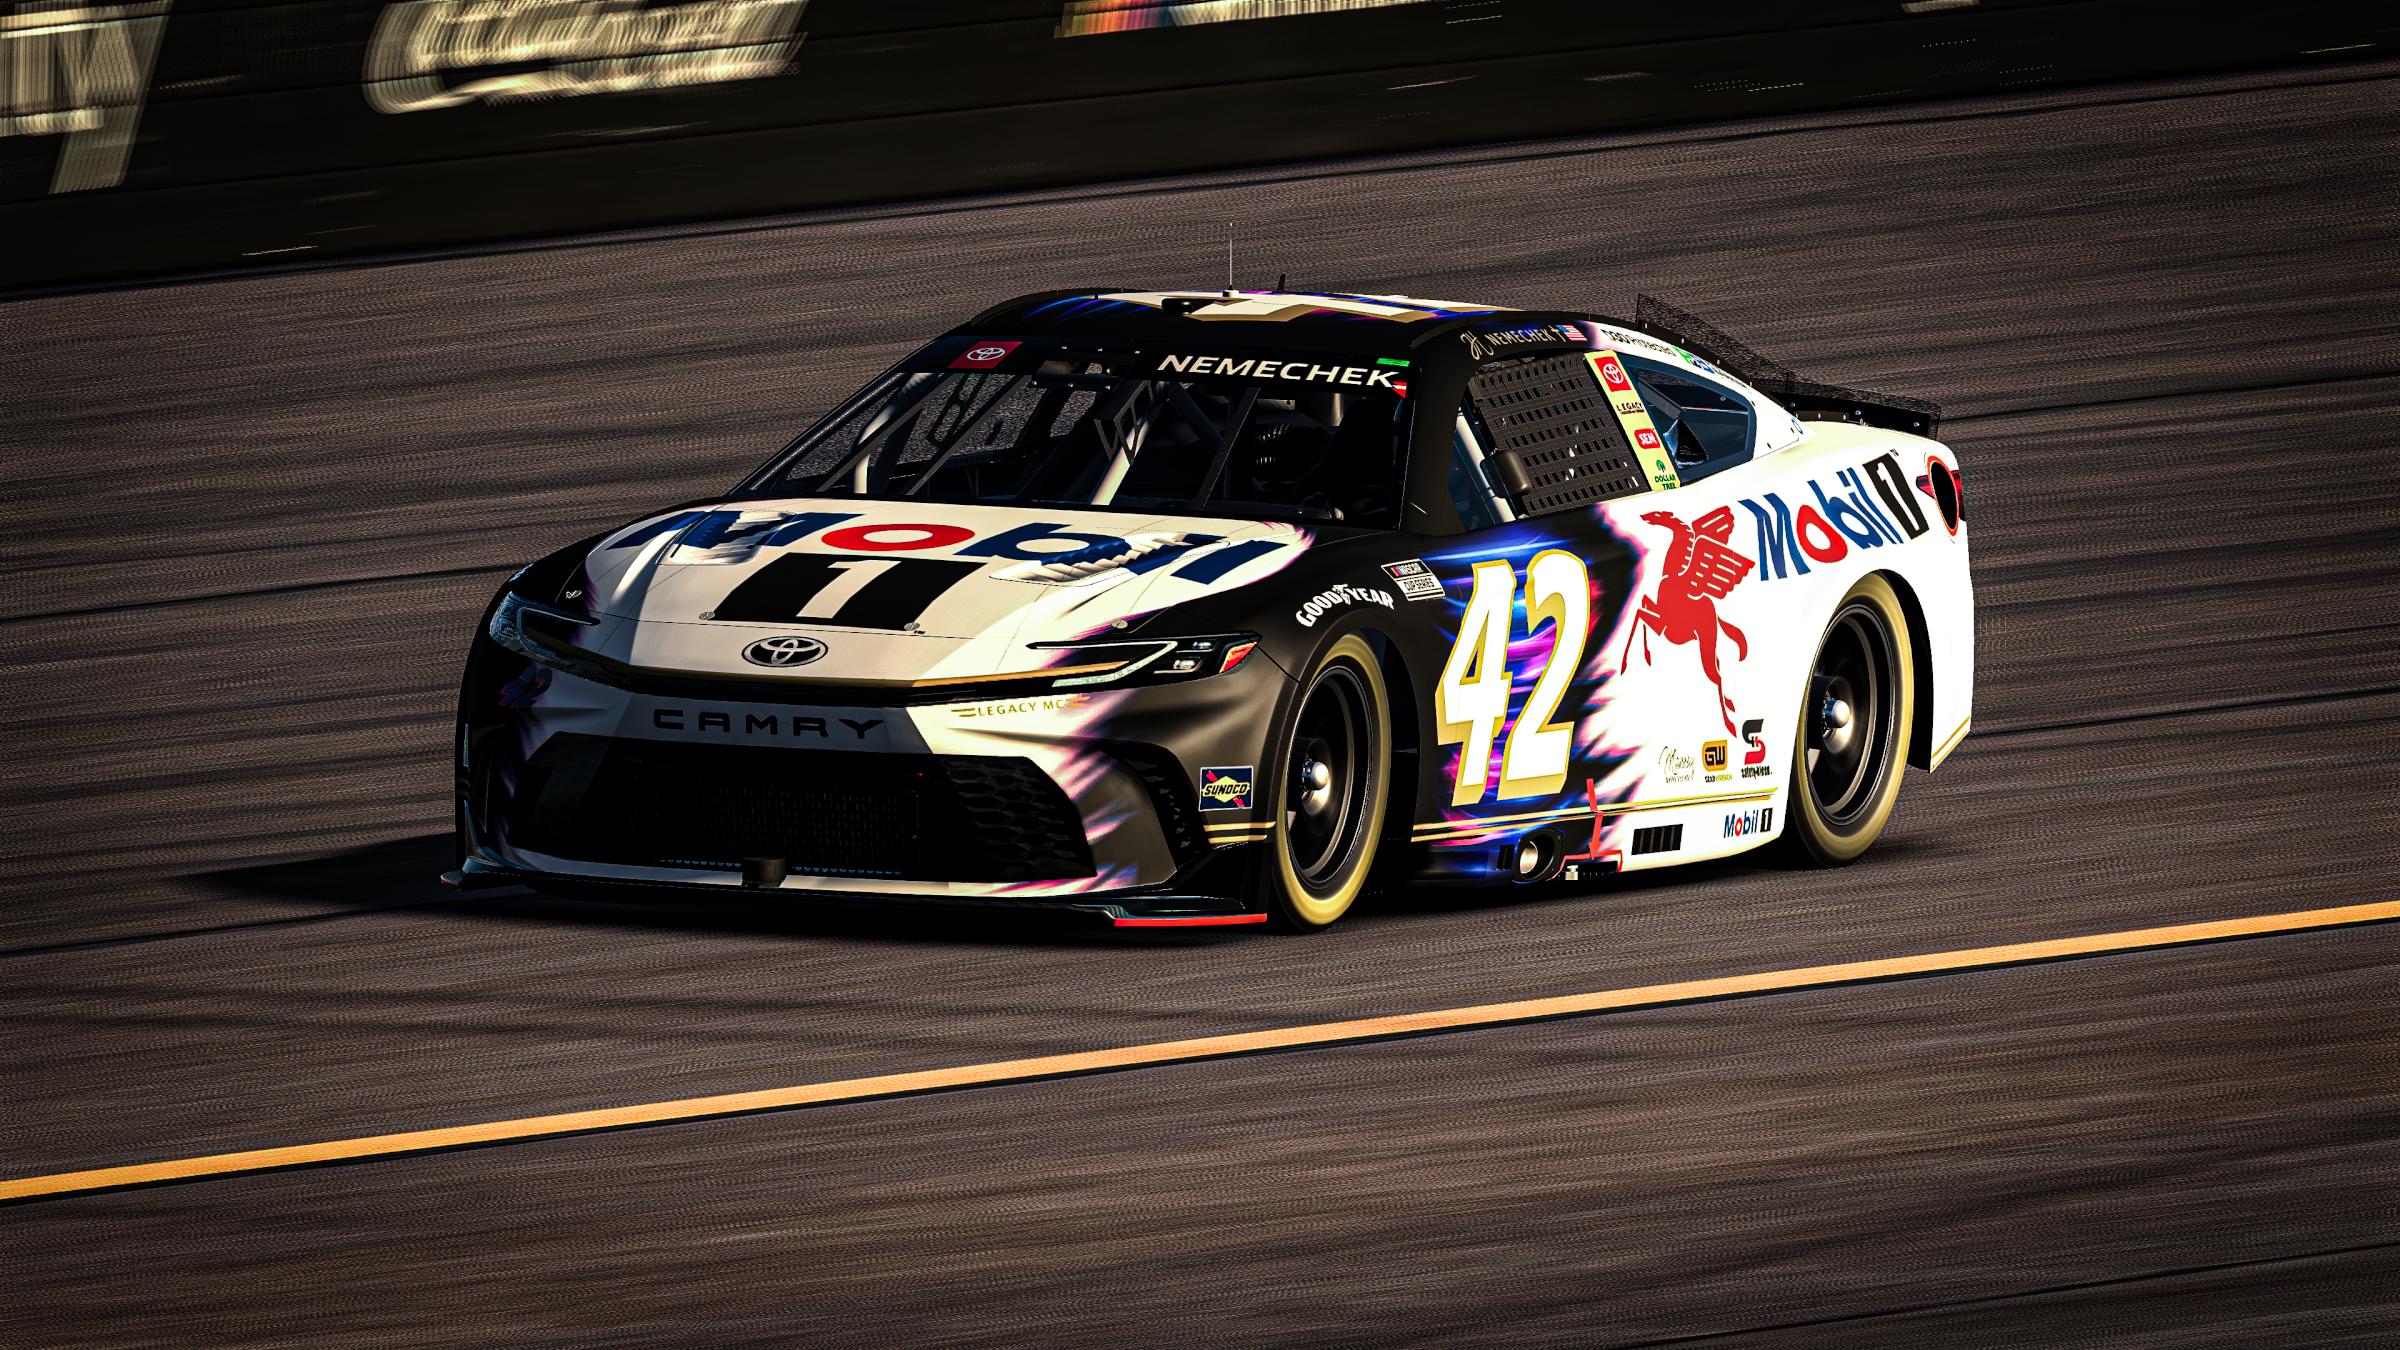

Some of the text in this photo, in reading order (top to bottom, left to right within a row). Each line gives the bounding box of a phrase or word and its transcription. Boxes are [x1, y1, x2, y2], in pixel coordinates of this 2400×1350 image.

[1484, 328, 1557, 346] NEMECHEK
[1157, 354, 1400, 388] NEMECHEK
[1638, 433, 1658, 445] SEM
[1654, 475, 1677, 483] DOLLAR
[1738, 466, 1905, 582] Mobil
[1295, 586, 1395, 628] GOODYEAR
[1435, 549, 1590, 807] 42
[977, 699, 1065, 716] LEGACY MC
[652, 708, 884, 740] CAMRY
[1204, 783, 1248, 796] SUNOCO
[1723, 809, 1759, 839] Mobil
